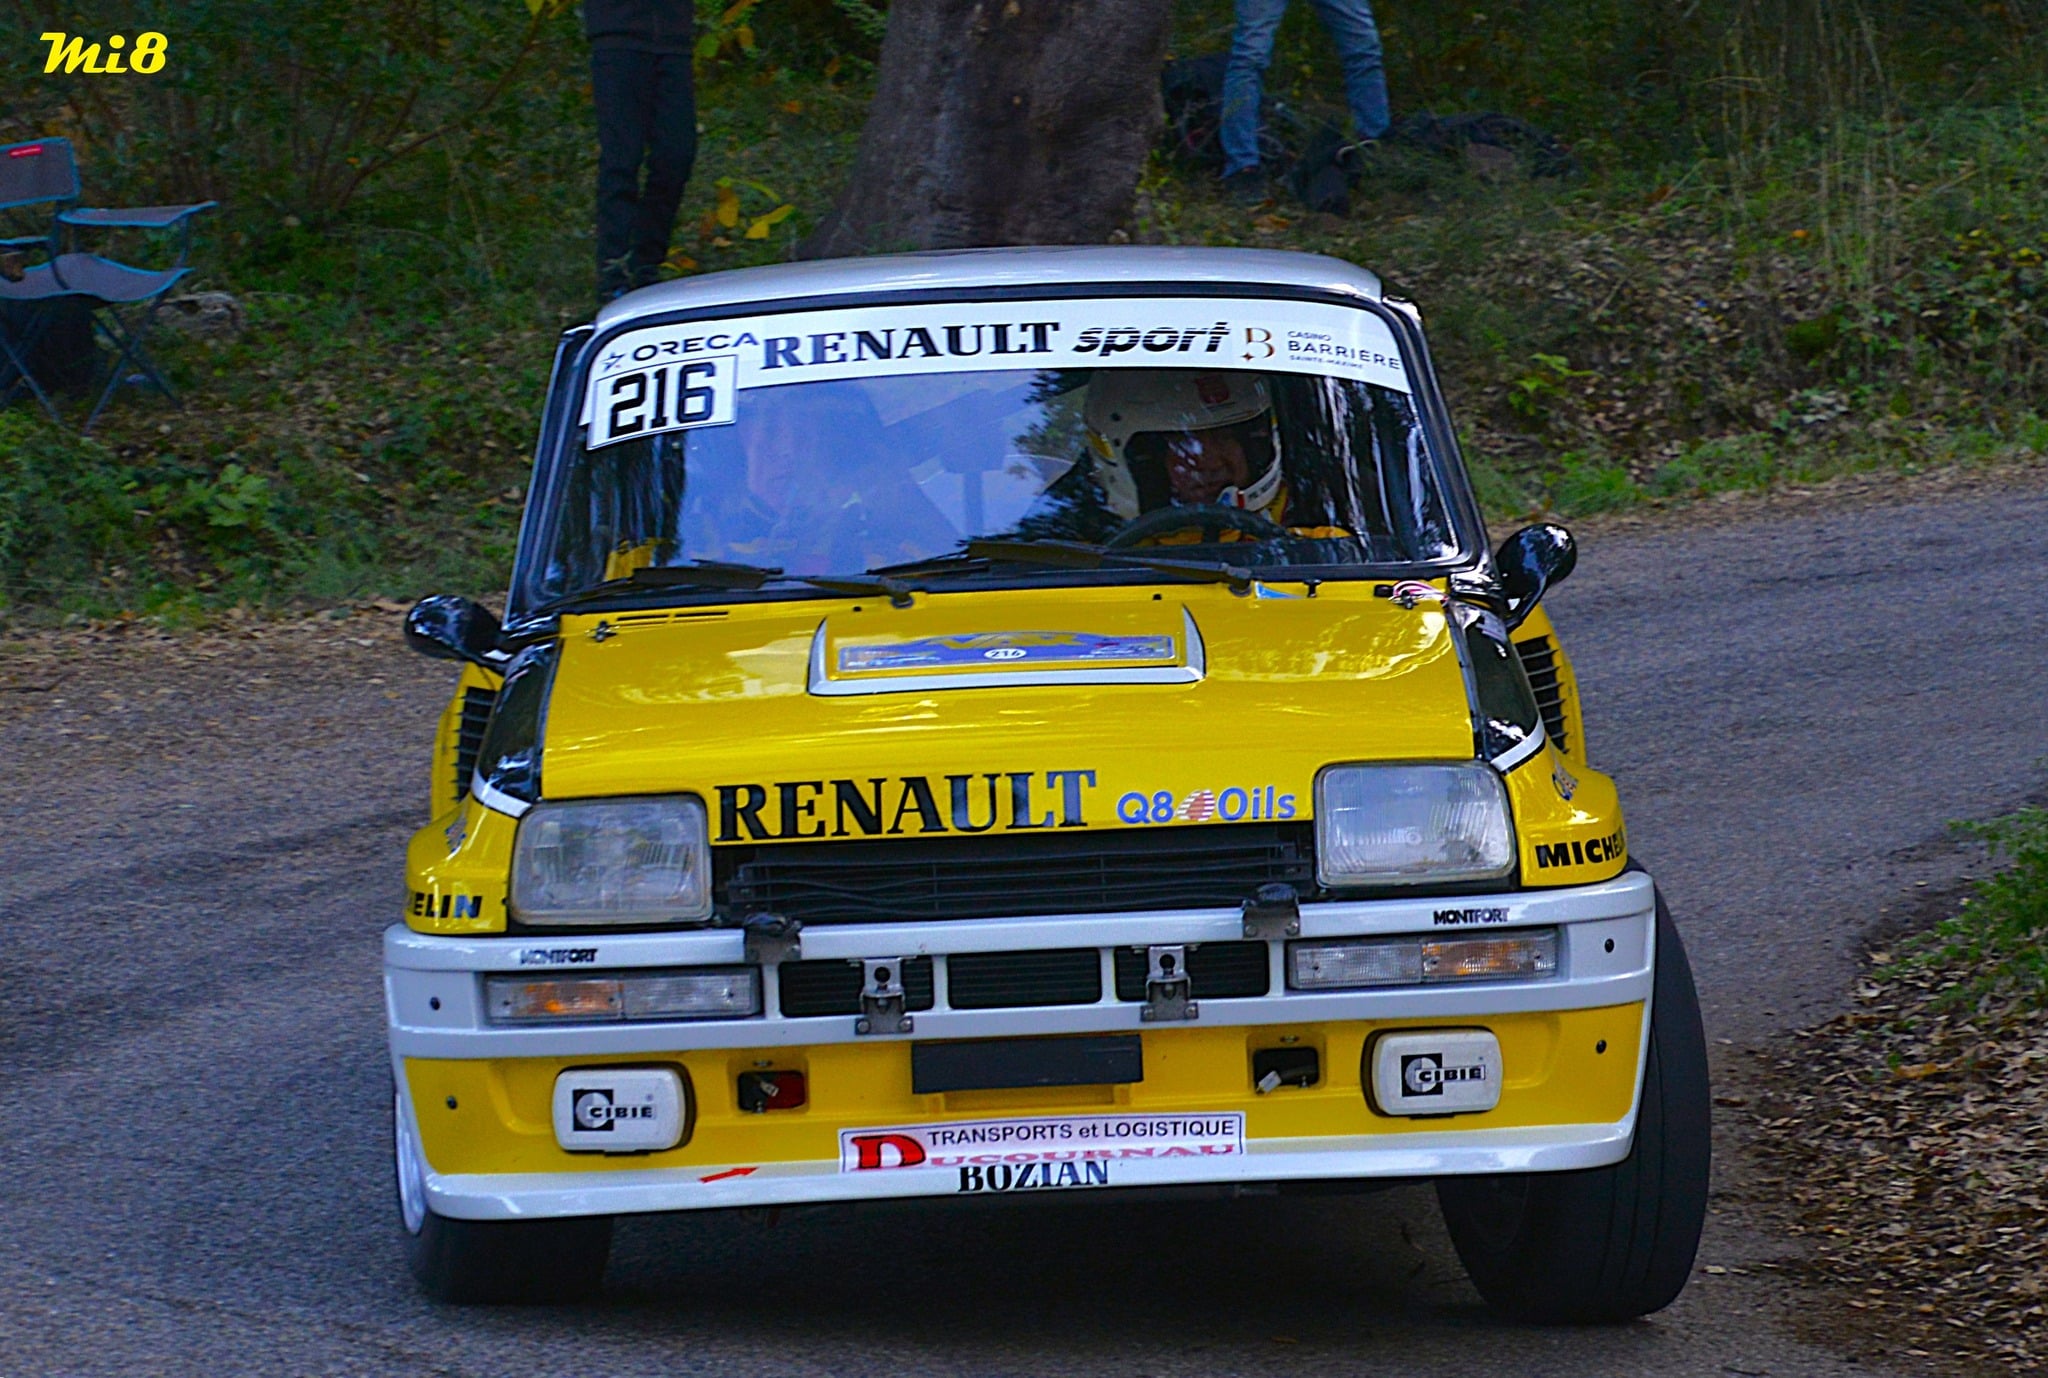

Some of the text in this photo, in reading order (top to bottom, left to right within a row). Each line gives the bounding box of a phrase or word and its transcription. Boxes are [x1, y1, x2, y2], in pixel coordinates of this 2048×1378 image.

[632, 331, 760, 362] ORECA
[761, 321, 1230, 370] RENAULT sport
[1287, 330, 1332, 342] CASINO
[609, 361, 715, 439] 216
[990, 649, 1022, 660] 216
[713, 769, 1097, 843] RENAULT
[1116, 786, 1297, 825] Q8 Oils
[1433, 907, 1511, 926] MONTFORT
[1417, 1067, 1483, 1083] CIBIE
[588, 1105, 655, 1119] CIBIE
[928, 1119, 1234, 1147] TRANSPORTS et LOGISTIQUE
[957, 1160, 1109, 1193] BOZIAN
